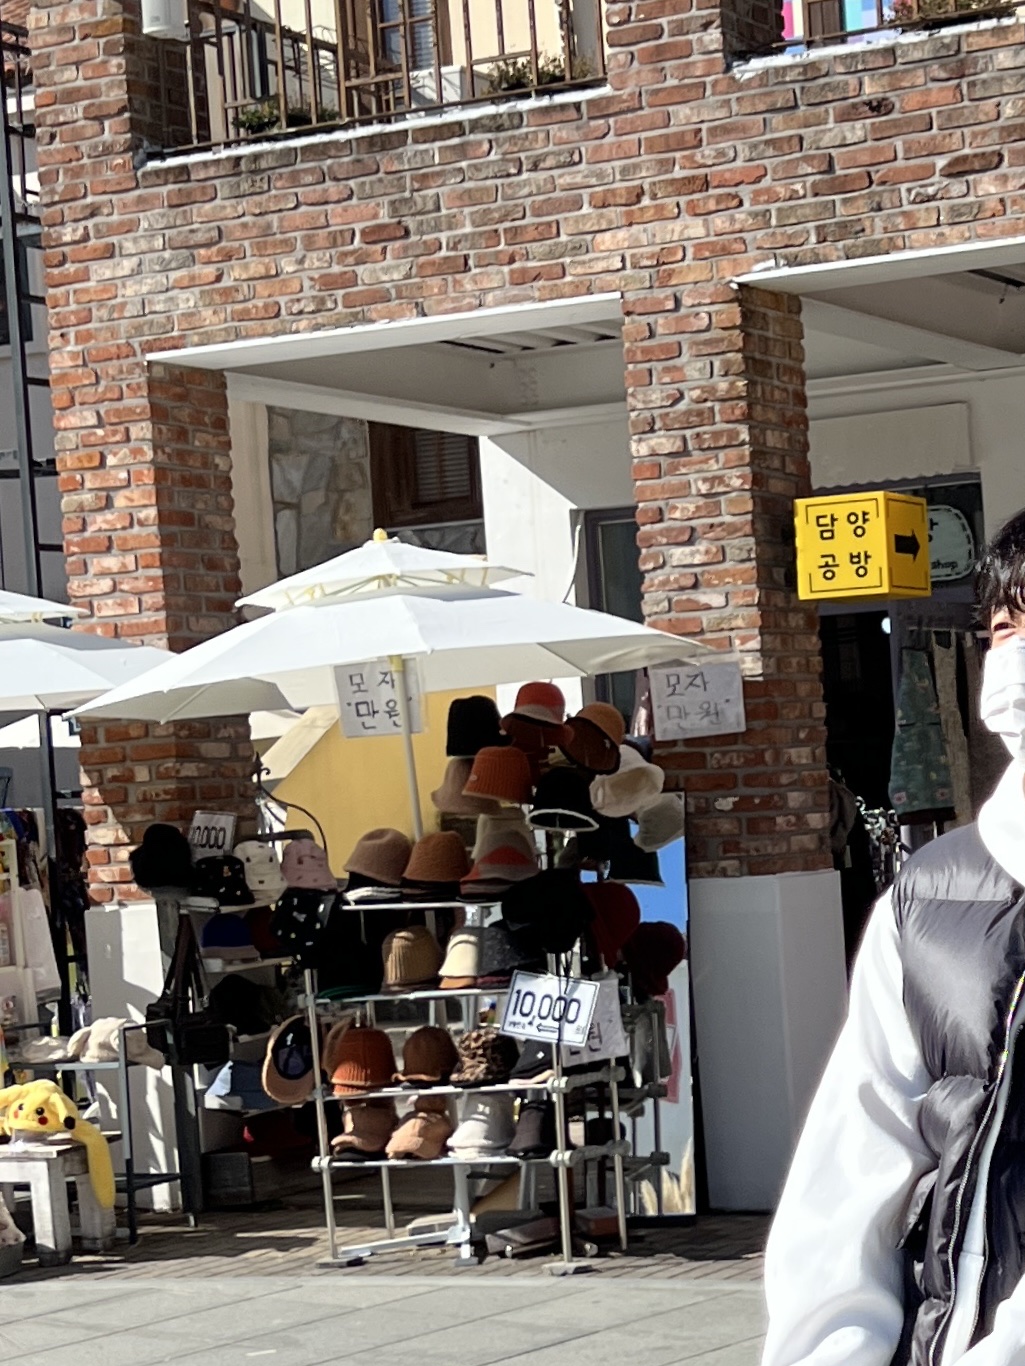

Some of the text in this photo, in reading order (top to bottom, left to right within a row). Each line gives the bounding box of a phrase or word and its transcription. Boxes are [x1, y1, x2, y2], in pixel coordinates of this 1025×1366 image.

[816, 510, 870, 541] 담양
[818, 550, 872, 581] 공방
[348, 670, 396, 694] 모자
[665, 670, 711, 698] 모자
[512, 988, 581, 1026] 10,000
